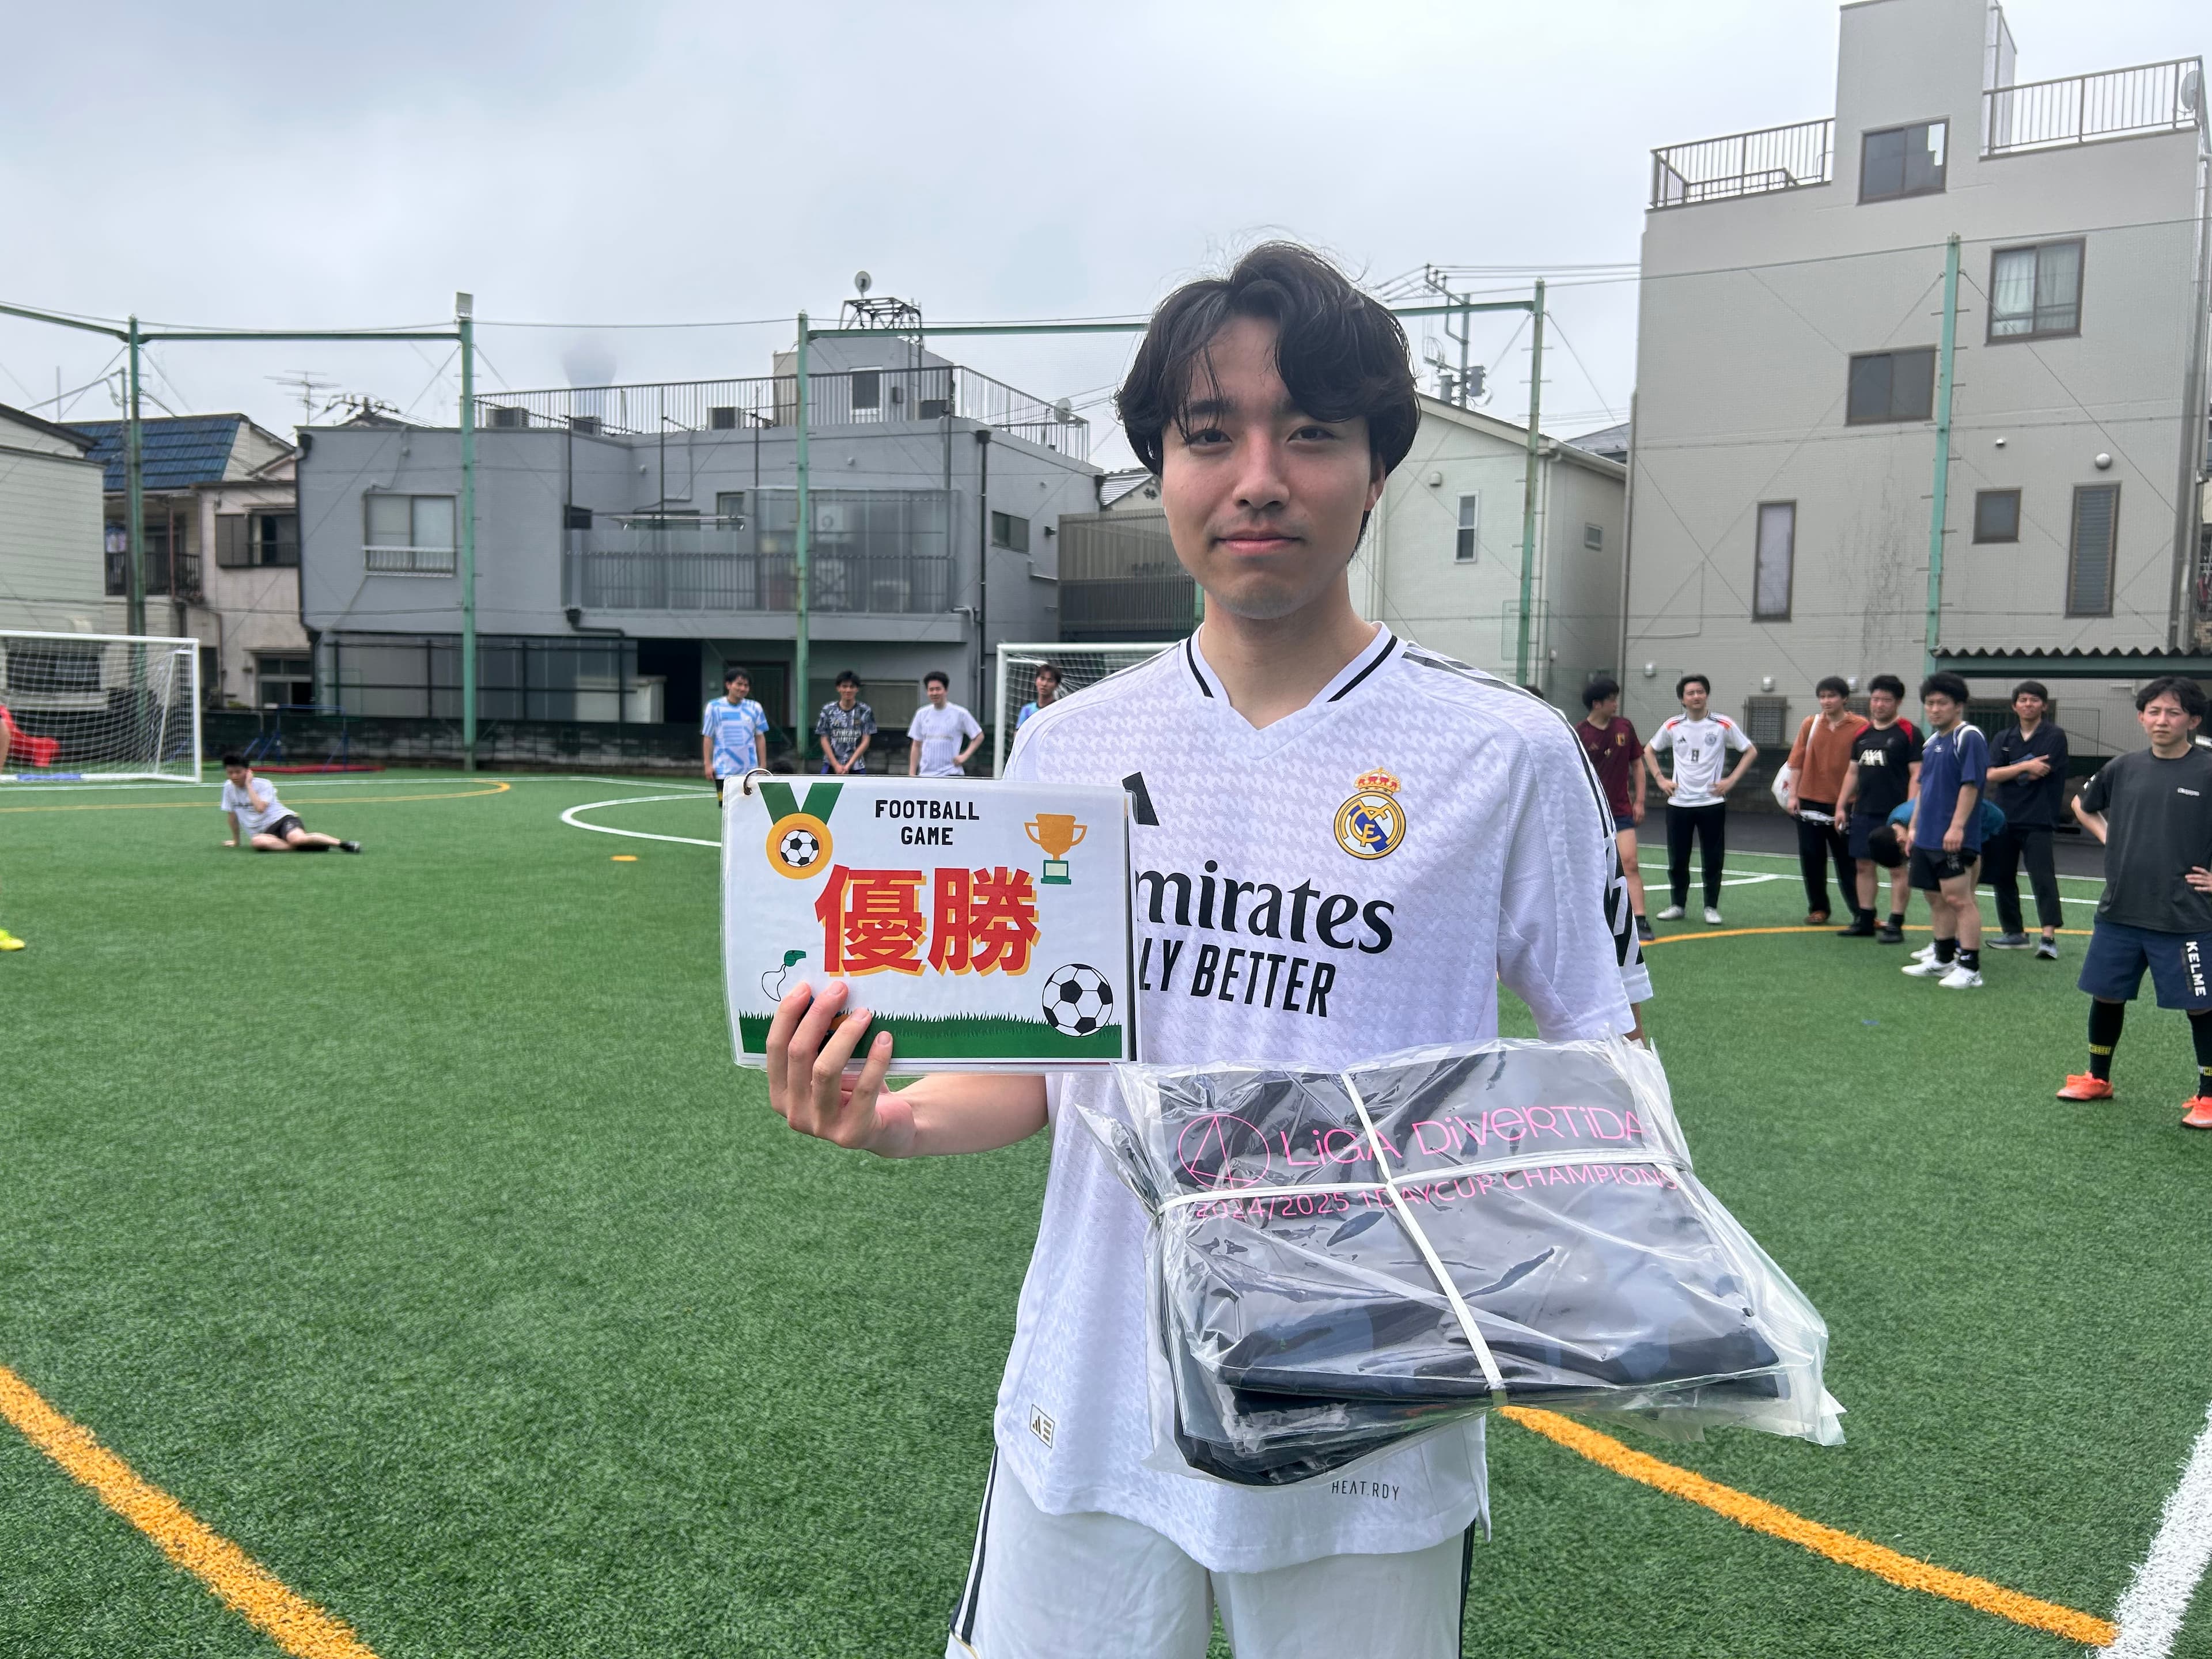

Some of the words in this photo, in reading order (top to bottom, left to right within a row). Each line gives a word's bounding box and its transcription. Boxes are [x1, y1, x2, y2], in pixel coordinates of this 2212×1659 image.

[875, 800, 980, 820] FOOTBALL
[901, 826, 953, 846] GAME
[815, 863, 1040, 977] 優勝
[1135, 859, 1395, 954] mirates
[1139, 937, 1184, 991] LY
[1190, 944, 1336, 1018] BETTER
[2186, 941, 2207, 997] KELME
[1196, 1191, 1350, 1220] 2024/2025
[1502, 1164, 1677, 1190] CHAMPIONS
[1331, 1480, 1400, 1501] HEAT.RDY
